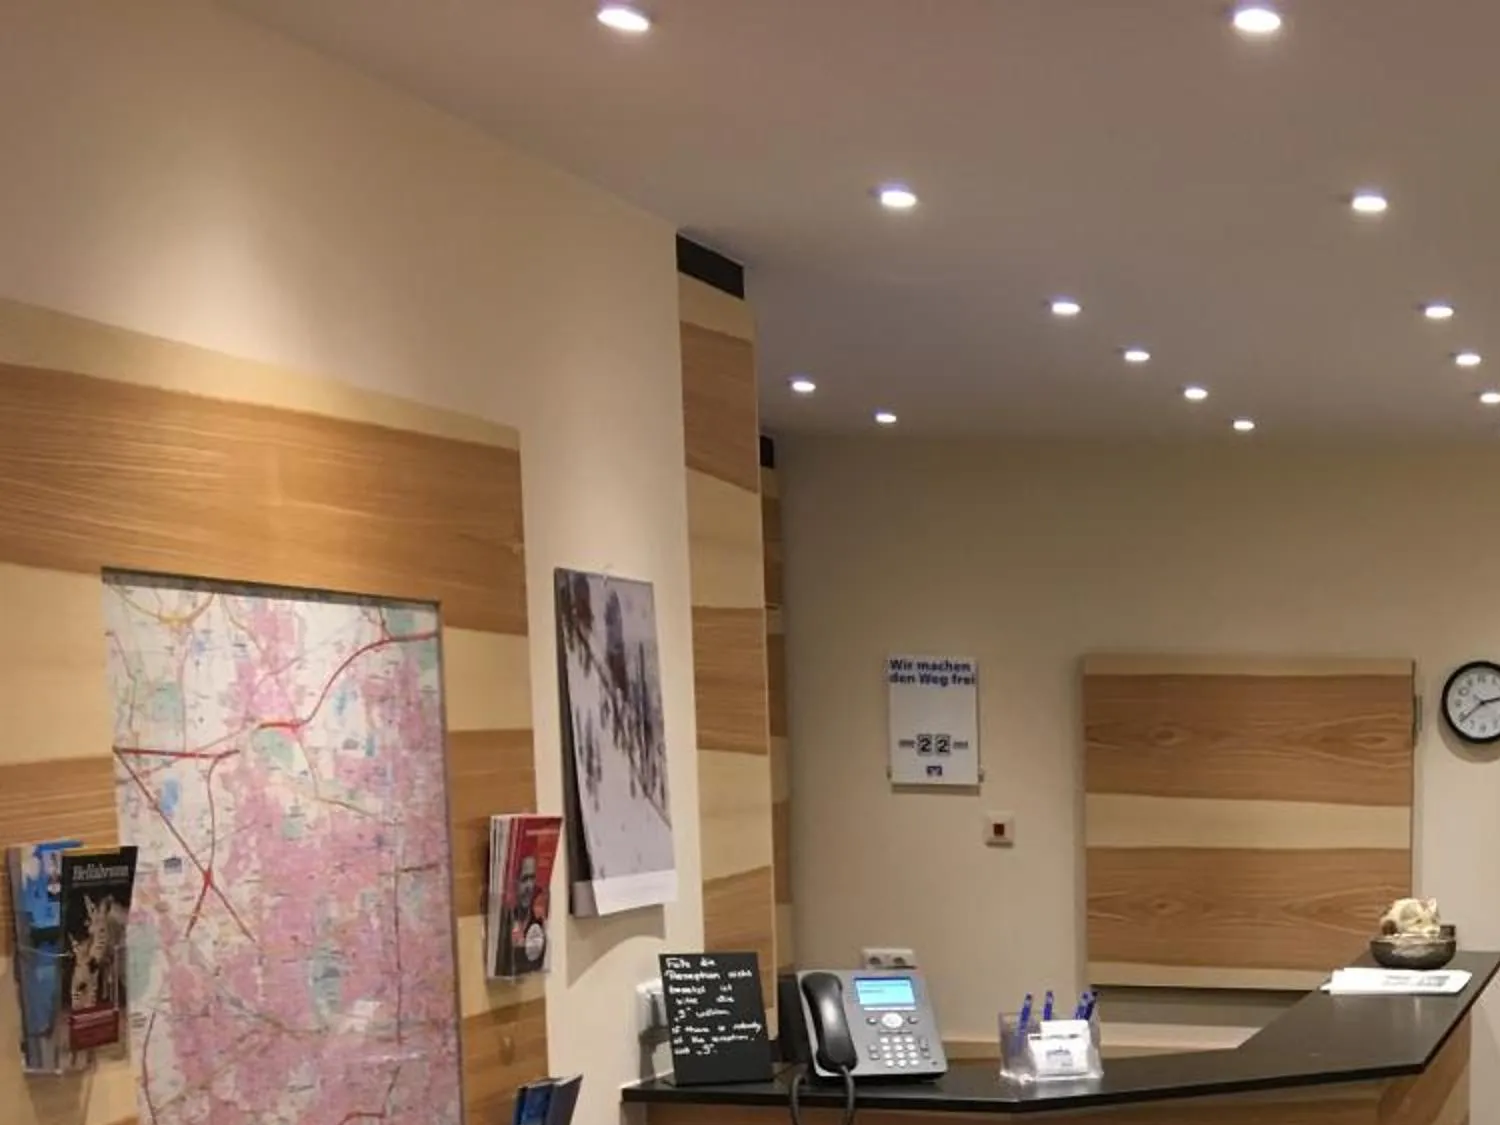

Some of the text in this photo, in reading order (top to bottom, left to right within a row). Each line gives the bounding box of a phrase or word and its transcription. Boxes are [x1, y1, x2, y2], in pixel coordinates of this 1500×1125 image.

[889, 658, 971, 671] Wir machen
[889, 671, 976, 687] den Weg frei
